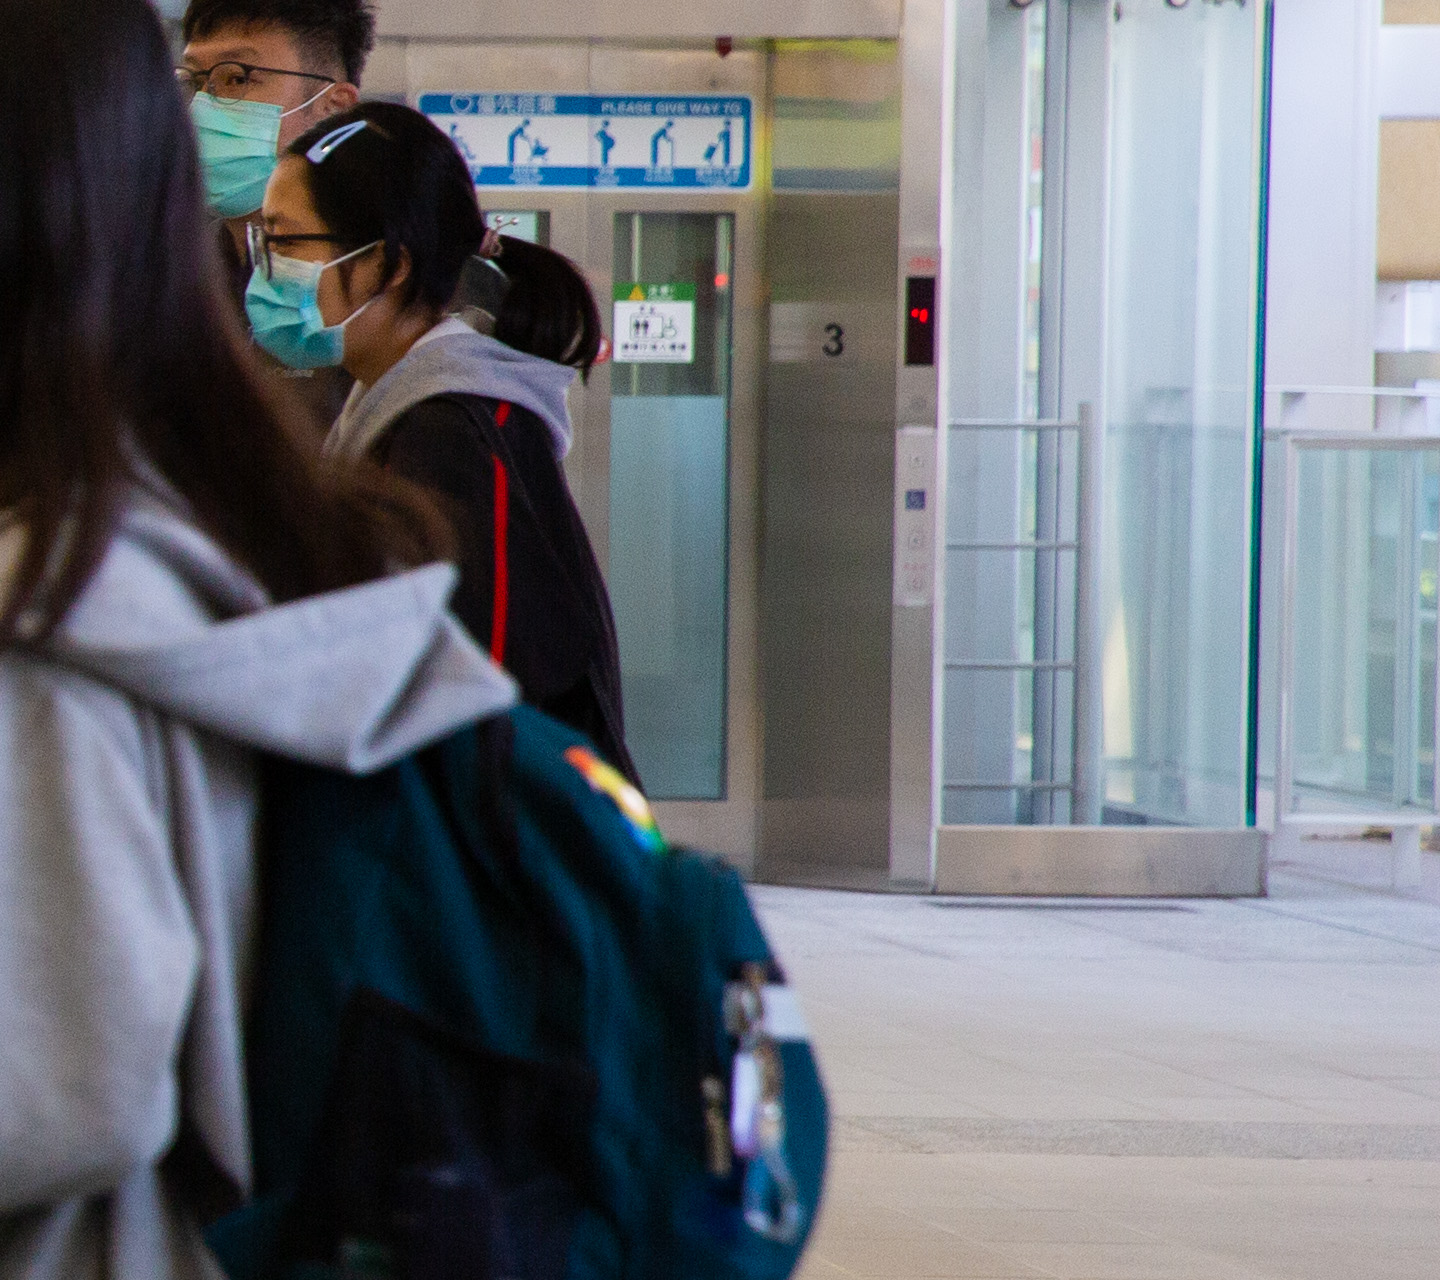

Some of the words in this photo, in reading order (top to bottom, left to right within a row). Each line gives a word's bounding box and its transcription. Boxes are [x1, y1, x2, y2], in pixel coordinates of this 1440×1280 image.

[601, 101, 652, 114] PLEASE
[655, 101, 686, 115] GIVE
[690, 102, 720, 115] WAY
[822, 323, 844, 357] 3
